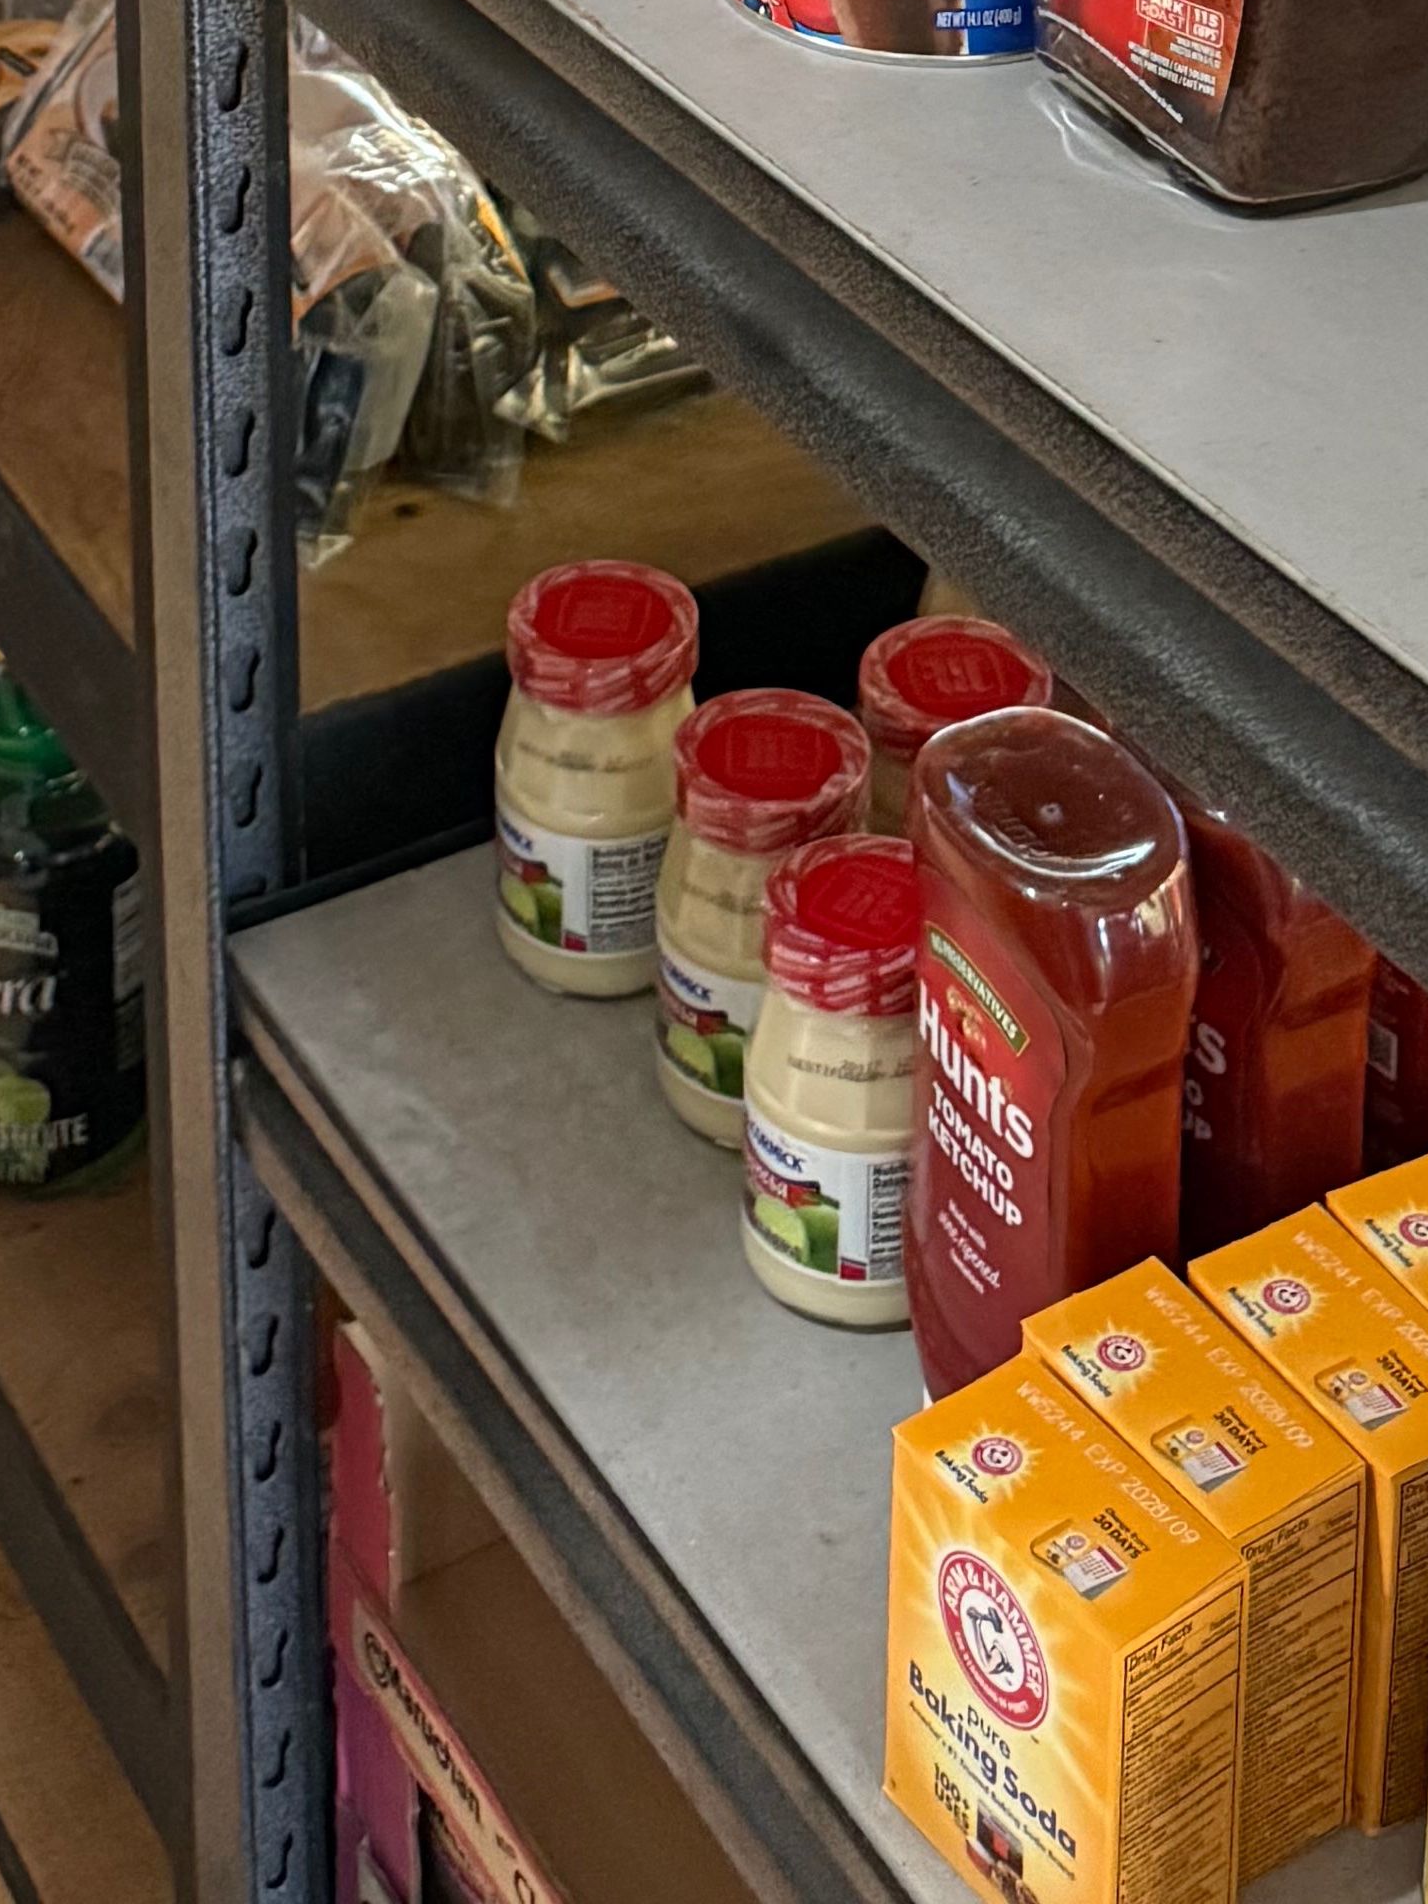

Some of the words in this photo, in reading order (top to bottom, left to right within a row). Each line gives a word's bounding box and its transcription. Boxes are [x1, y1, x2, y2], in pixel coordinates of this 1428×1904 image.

[1138, 2, 1186, 31] ROAST
[1192, 7, 1220, 29] 115
[931, 1078, 1015, 1193] TOMATO
[927, 1102, 1024, 1228] KETCHUP
[1358, 1286, 1405, 1323] EXP
[1205, 1346, 1247, 1379] EXP
[1375, 1353, 1396, 1376] 30
[1389, 1365, 1423, 1401] DAYS
[1213, 1409, 1234, 1434] 30
[1227, 1423, 1259, 1457] DAYS
[1016, 1379, 1087, 1443] WW5244
[1083, 1443, 1128, 1486] EXP
[1119, 1473, 1202, 1547] 2028/09
[1092, 1512, 1114, 1538] 30
[1108, 1528, 1143, 1561] DAYS
[1245, 1530, 1275, 1562] Drug
[1276, 1517, 1311, 1542] Facts
[943, 1566, 969, 1615] ARM
[966, 1560, 980, 1588] &
[981, 1570, 1045, 1701] HAMMER
[1128, 1641, 1158, 1673] Drug
[1161, 1621, 1194, 1652] Facts
[966, 1703, 1013, 1761] pure
[907, 1660, 999, 1786] Baking
[1001, 1768, 1078, 1860] Soda
[933, 1760, 971, 1812] 100+
[933, 1781, 971, 1832] USES
